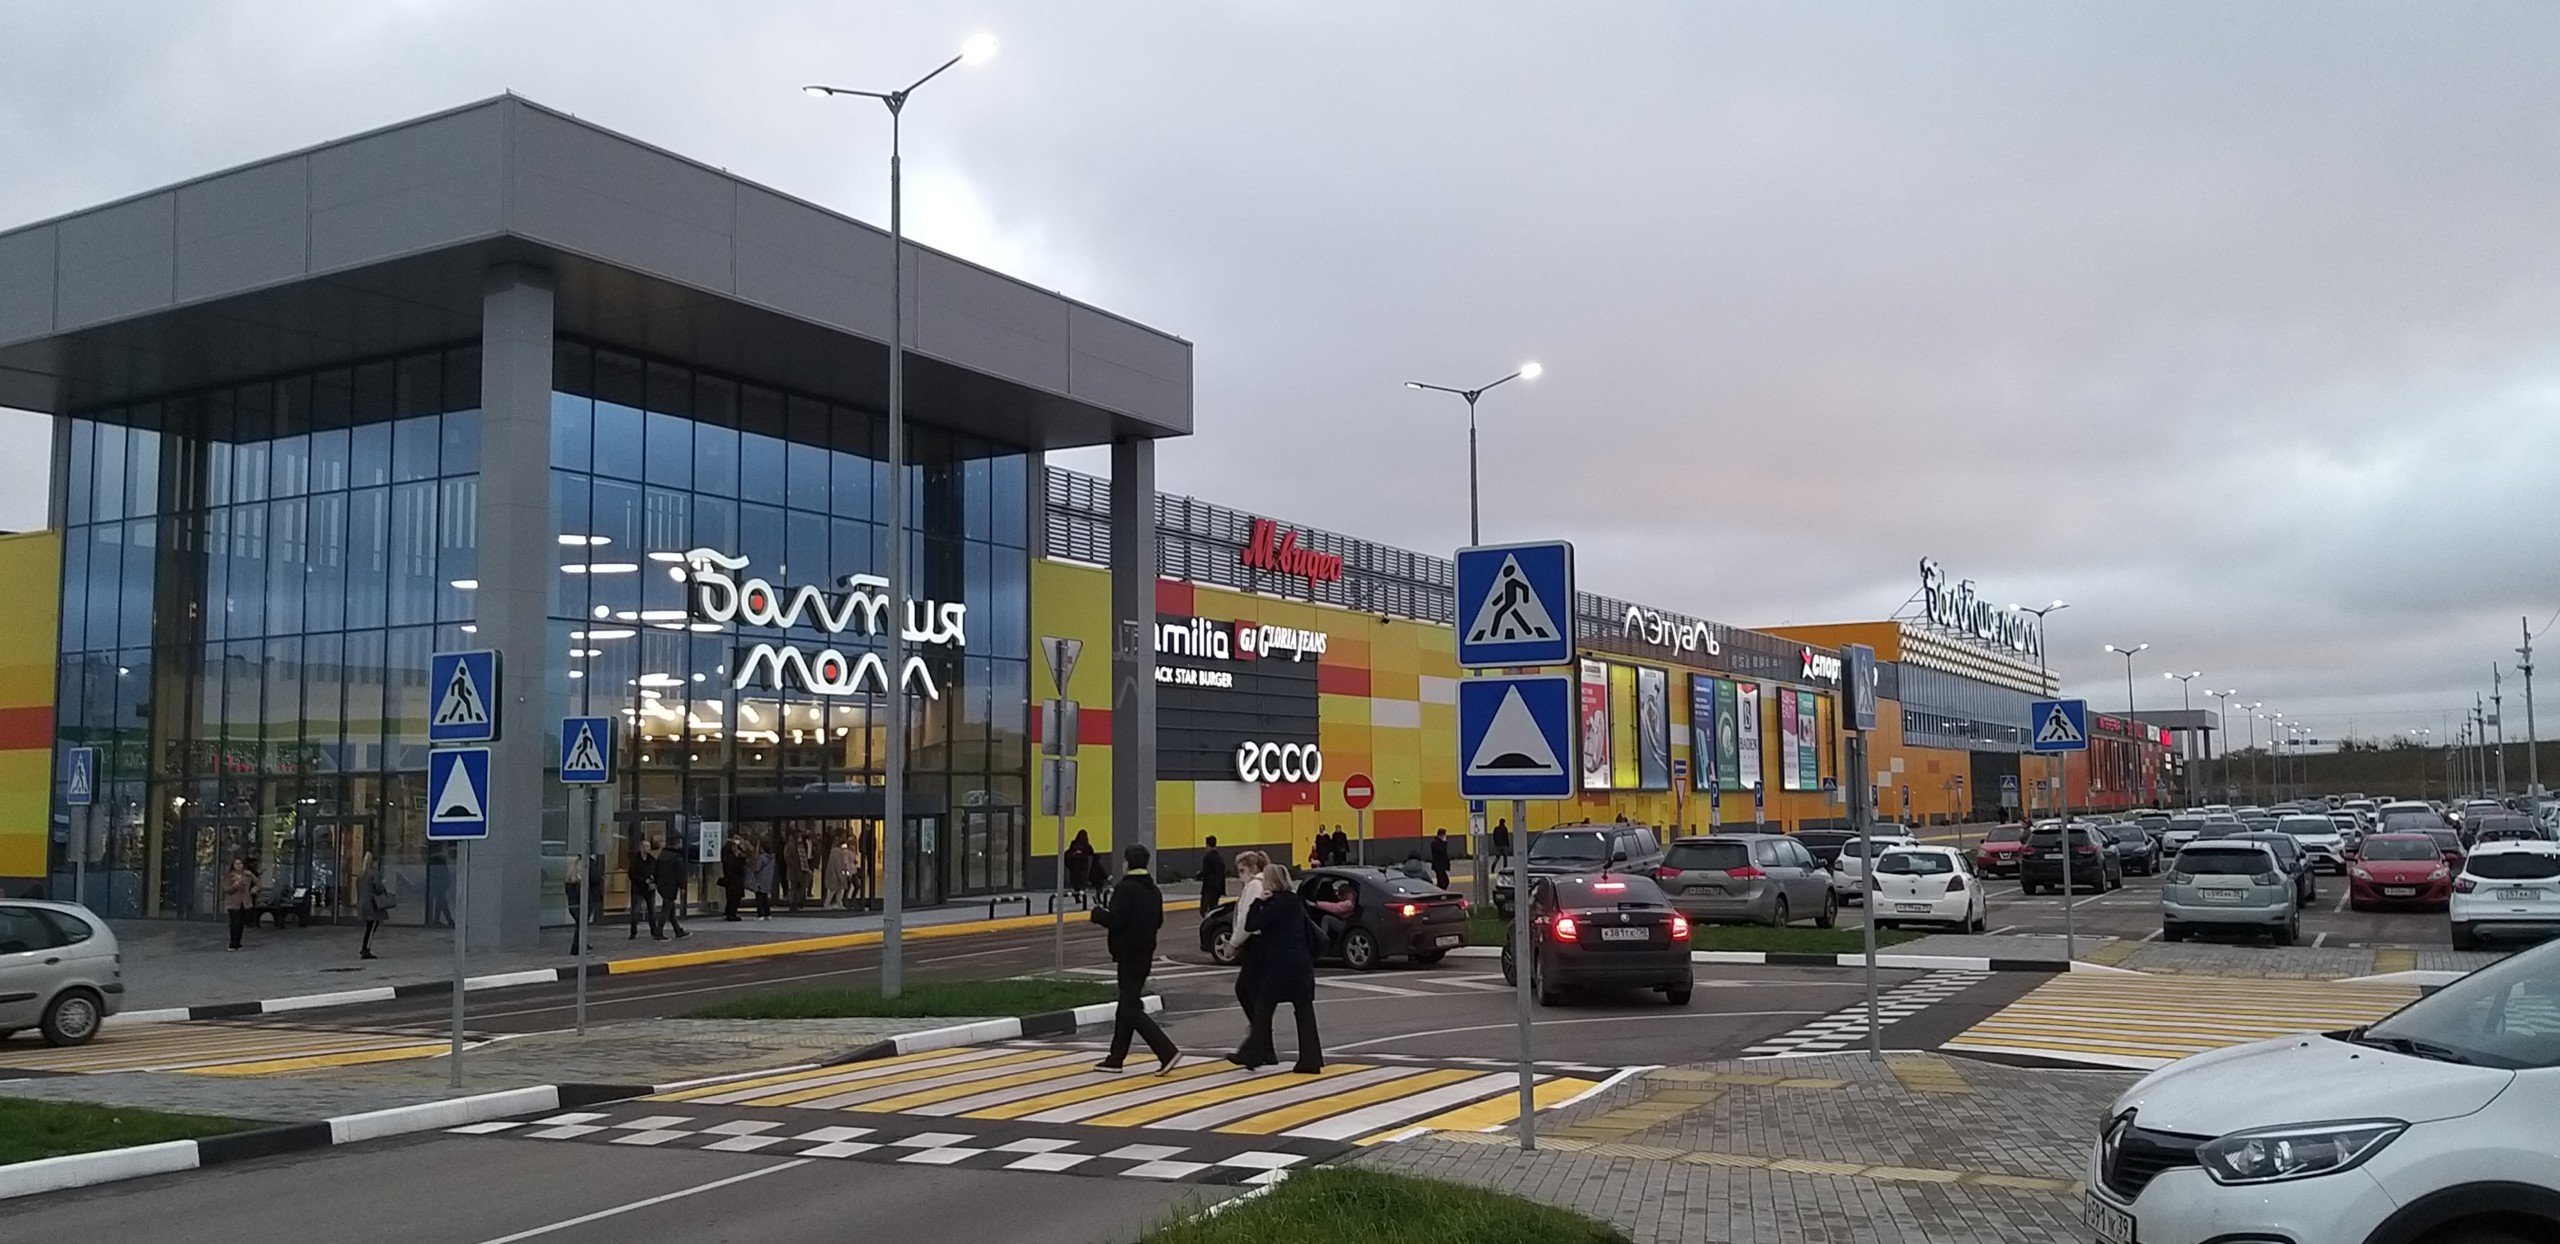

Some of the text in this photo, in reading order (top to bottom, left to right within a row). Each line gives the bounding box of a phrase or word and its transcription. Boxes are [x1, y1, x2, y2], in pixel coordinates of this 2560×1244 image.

[1154, 665, 1233, 688] ACK STAR BURGER
